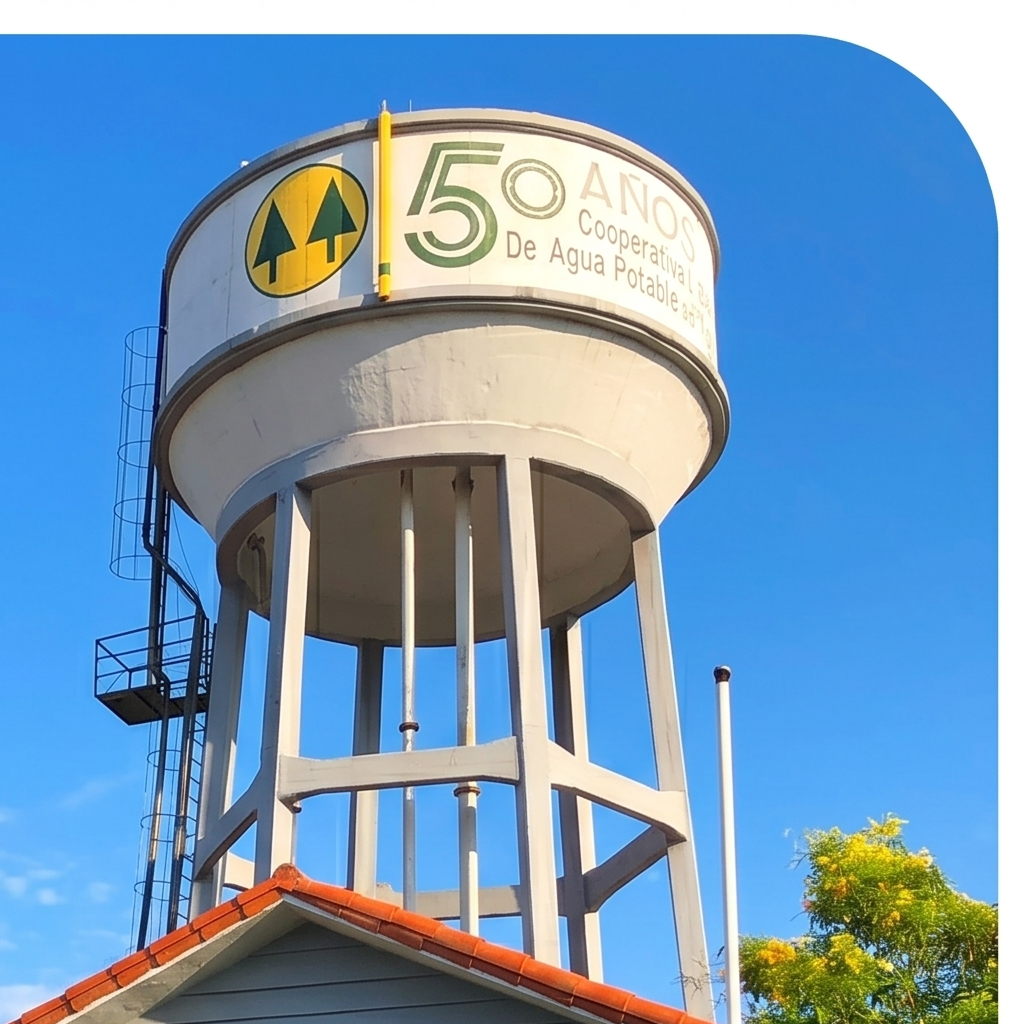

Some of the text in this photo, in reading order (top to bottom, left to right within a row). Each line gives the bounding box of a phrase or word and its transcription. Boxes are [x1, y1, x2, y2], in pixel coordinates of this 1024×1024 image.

[404, 141, 695, 268] 50 AÑOS
[506, 230, 537, 261] De
[549, 237, 605, 275] Agua
[614, 255, 678, 313] Potable
